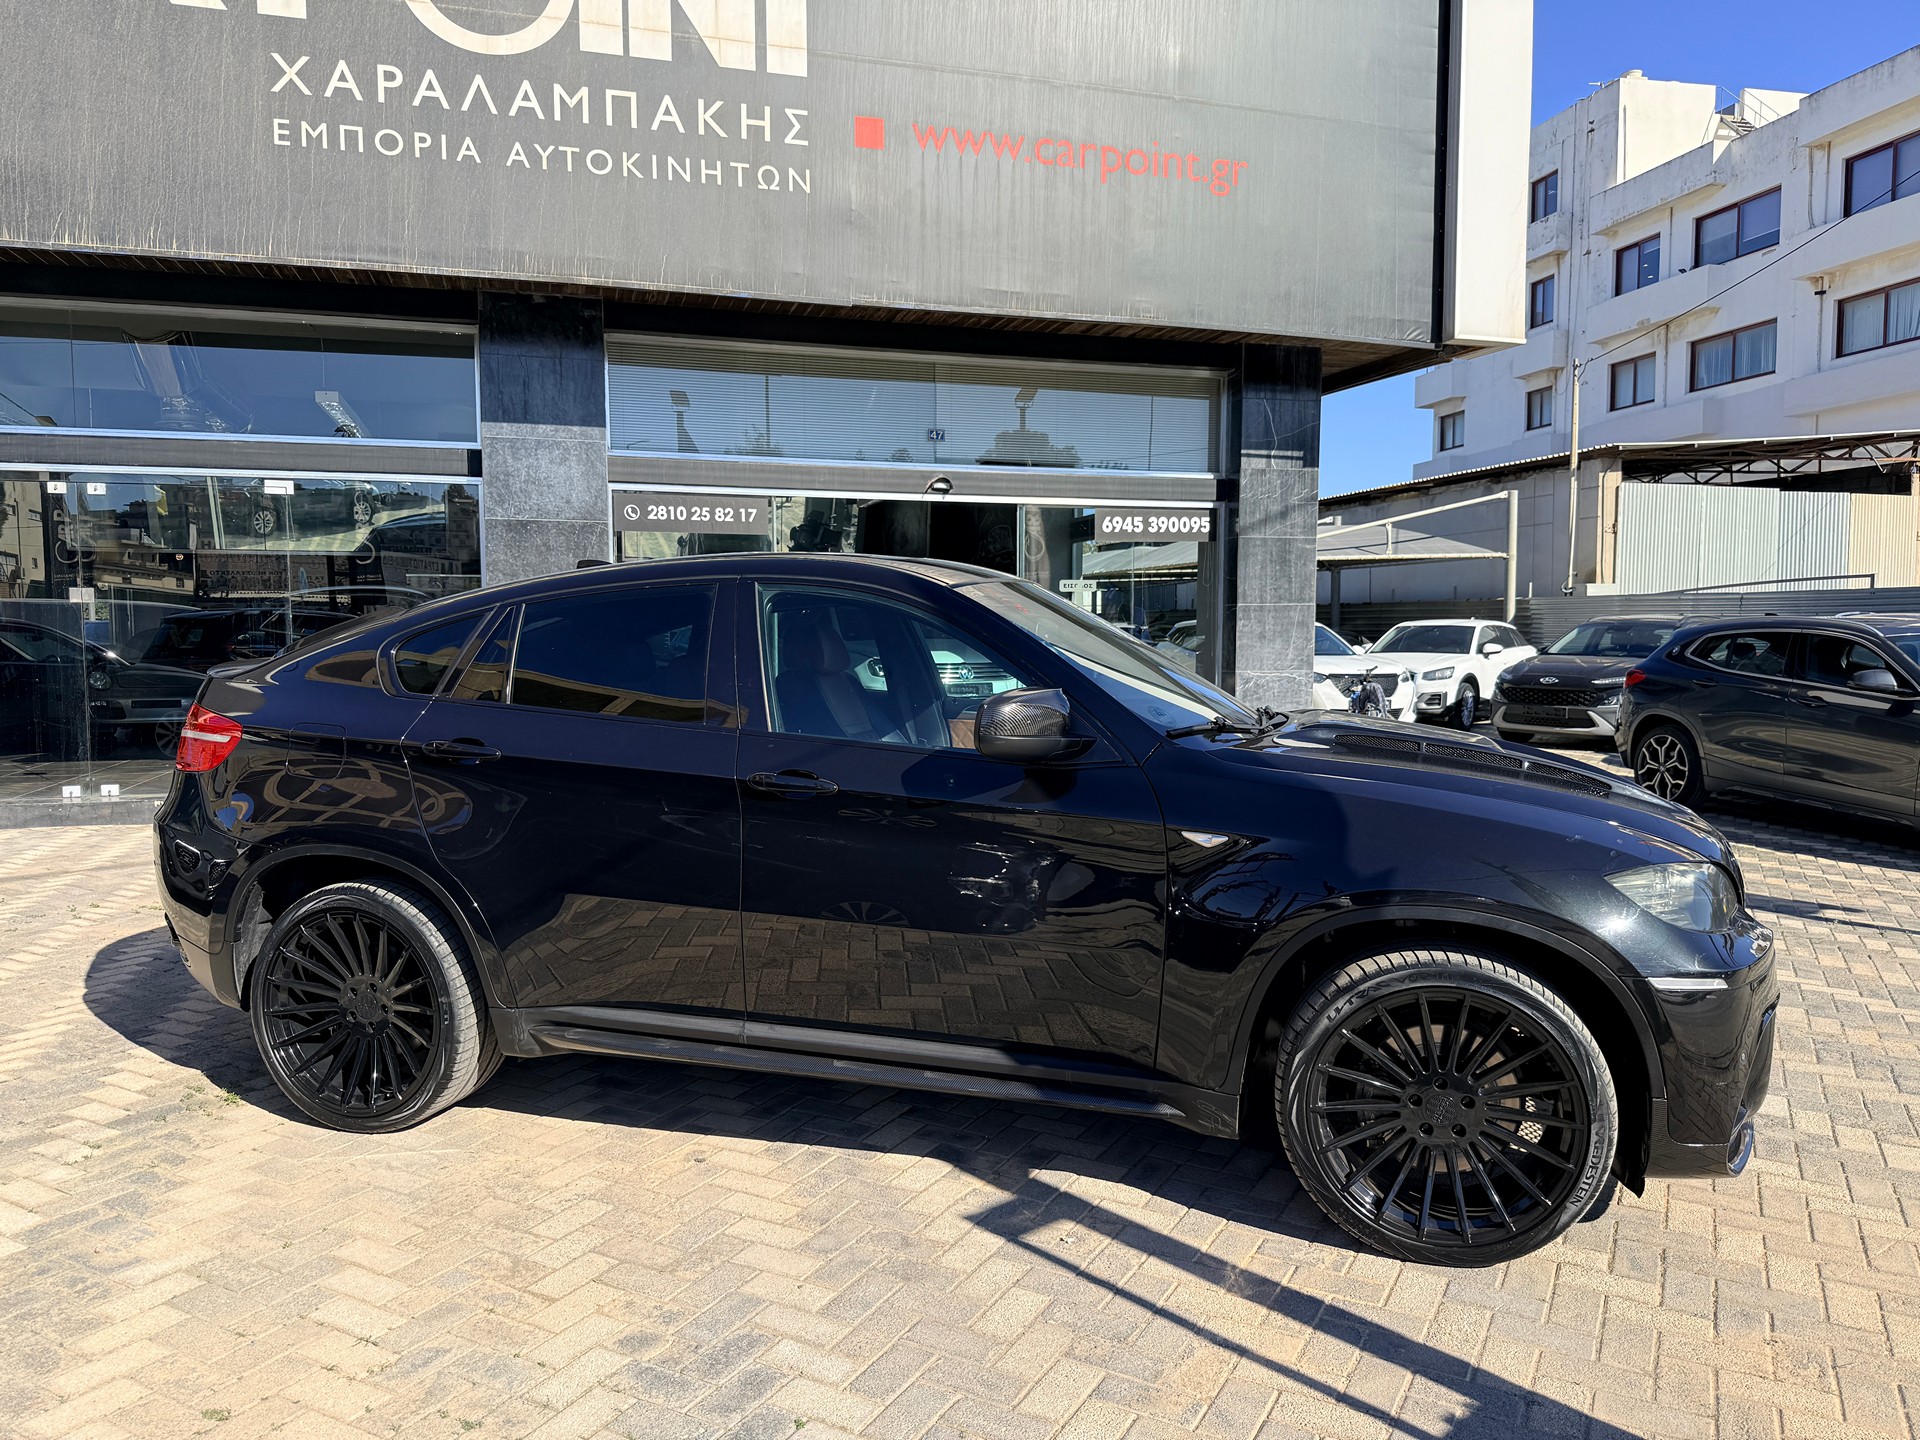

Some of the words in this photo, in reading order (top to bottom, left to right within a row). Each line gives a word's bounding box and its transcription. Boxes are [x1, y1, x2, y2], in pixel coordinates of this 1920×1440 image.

[270, 52, 809, 147] ΧΑΡΑΛΑΜΠΑΚΗΣ
[272, 118, 482, 164] ΕΜΠΟΡΙΑ
[505, 141, 811, 194] ΑΥΤΟΚΙΝΗΤΩΝ
[912, 122, 1249, 197] www.carpoint.gr
[930, 430, 943, 440] 47
[647, 505, 687, 521] 2810
[690, 506, 711, 521] 25
[714, 507, 735, 522] 82
[739, 508, 758, 523] 17
[1101, 516, 1144, 533] 6945
[1147, 516, 1211, 533] 390095
[1569, 1124, 1606, 1207] VREDESTEIN
